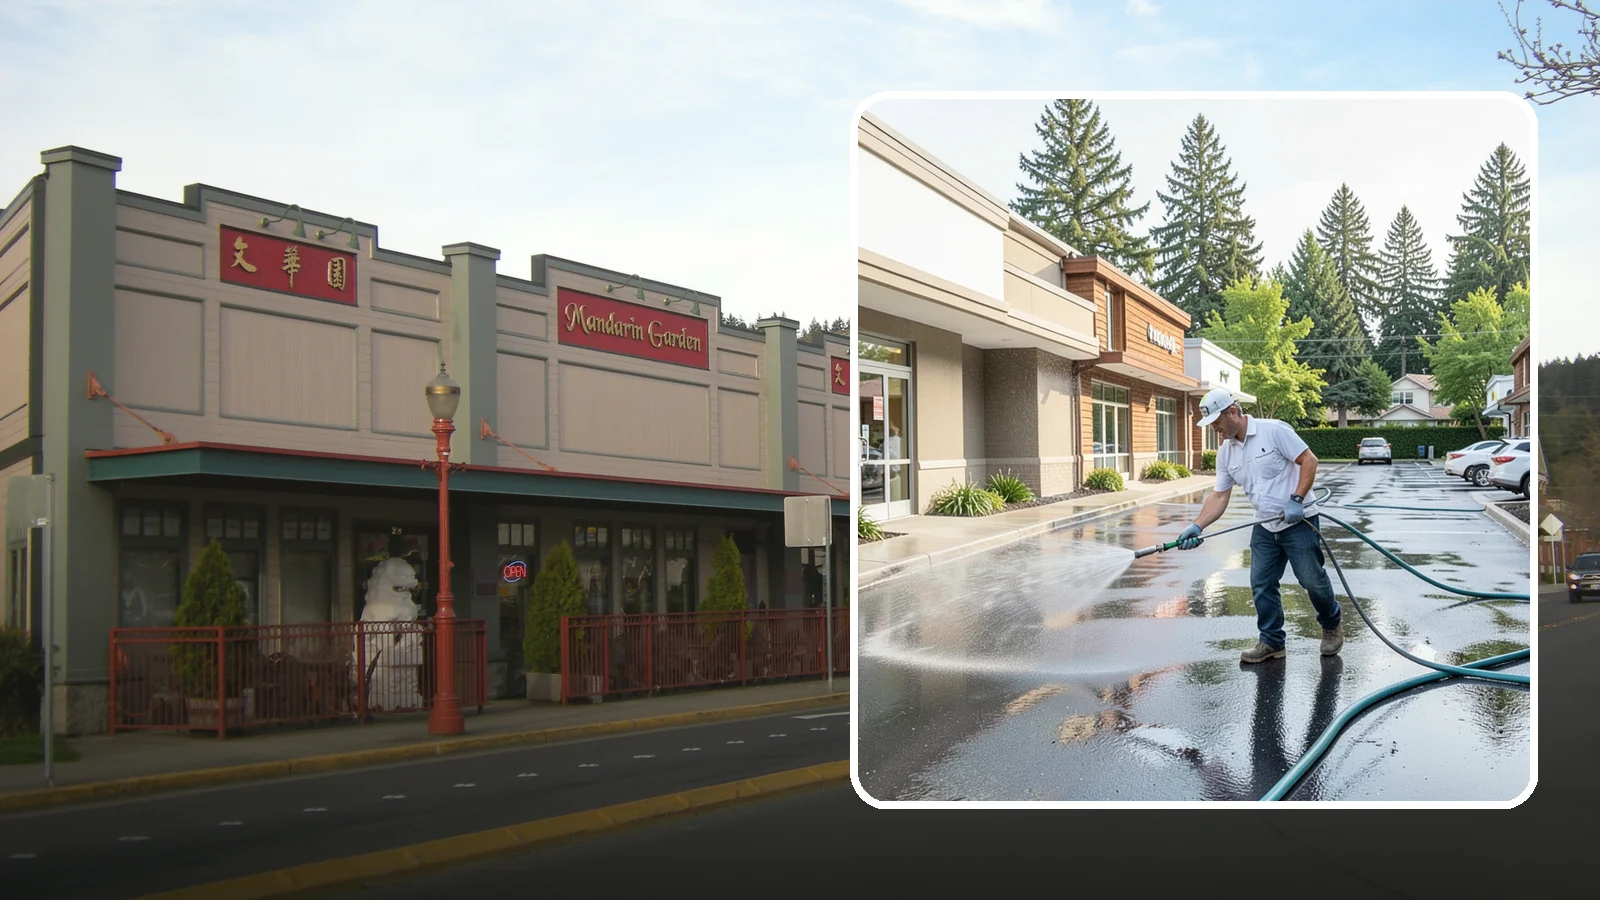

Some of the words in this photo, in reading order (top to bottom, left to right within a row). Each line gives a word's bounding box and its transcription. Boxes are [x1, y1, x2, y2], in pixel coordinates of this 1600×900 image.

[230, 235, 346, 291] 文華園
[564, 302, 644, 341] Mandarin
[647, 320, 701, 352] Garden
[503, 565, 527, 578] OPEN
